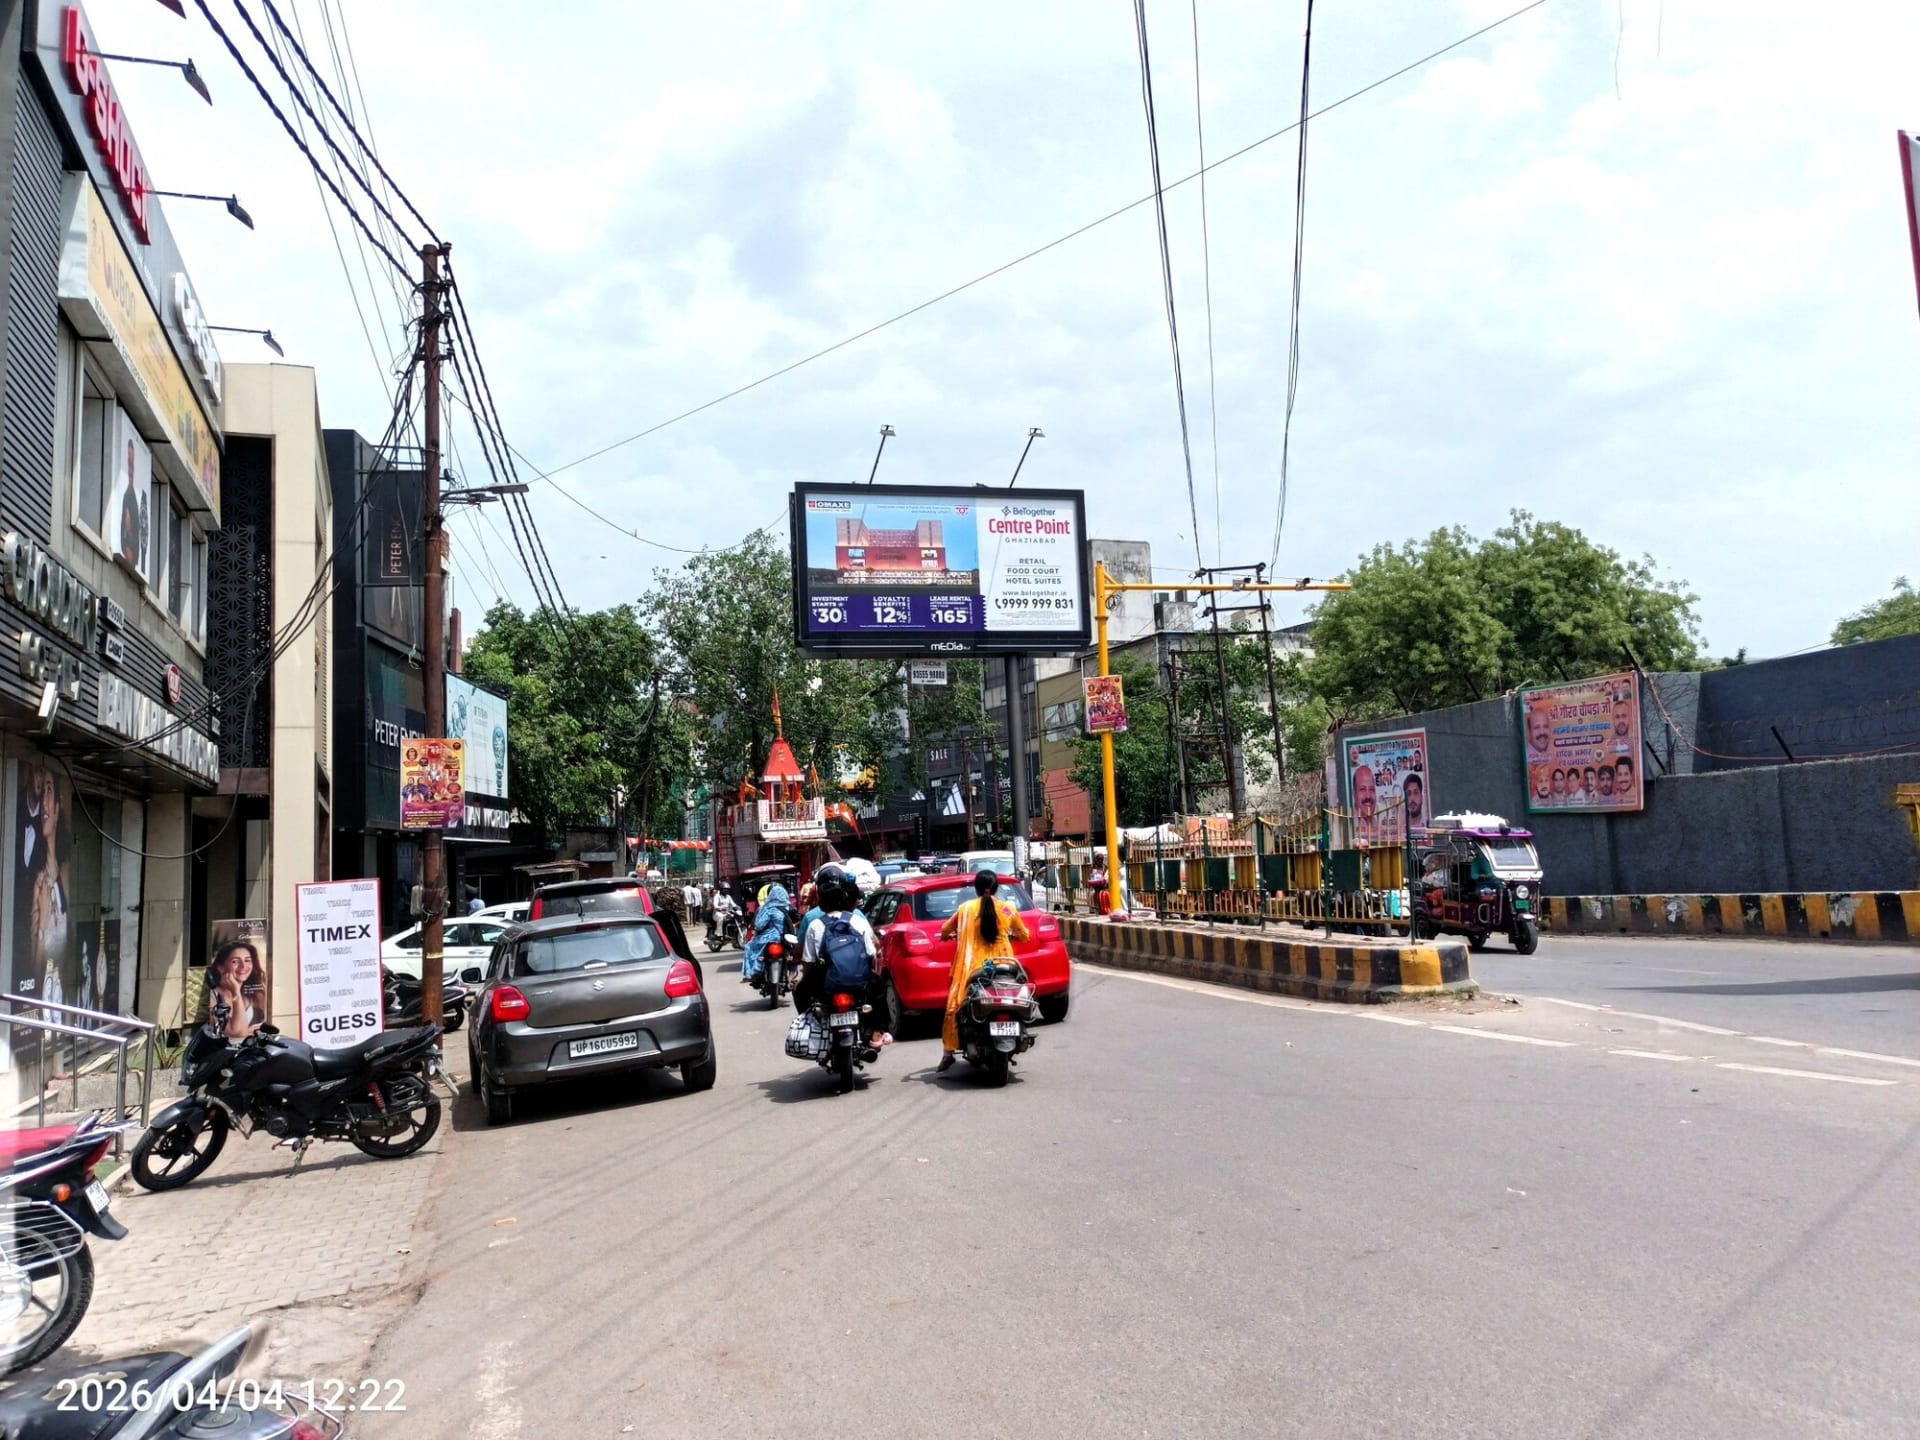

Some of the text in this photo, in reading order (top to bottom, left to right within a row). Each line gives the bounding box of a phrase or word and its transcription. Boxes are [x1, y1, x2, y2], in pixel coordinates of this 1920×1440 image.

[816, 501, 850, 509] OMAXE
[1012, 507, 1056, 517] BeTogether
[988, 518, 1071, 535] Centre Point
[390, 542, 402, 574] PETER
[1007, 567, 1060, 575] FOOD COURT
[1005, 577, 1032, 585] HOTEL
[1001, 598, 1074, 609] 9999 999 831
[873, 606, 908, 624] 12%
[374, 718, 399, 748] PETER
[930, 748, 948, 760] SALE
[483, 807, 510, 829] WORLD
[306, 924, 372, 943] TIMEX
[308, 1012, 377, 1034] GUESS
